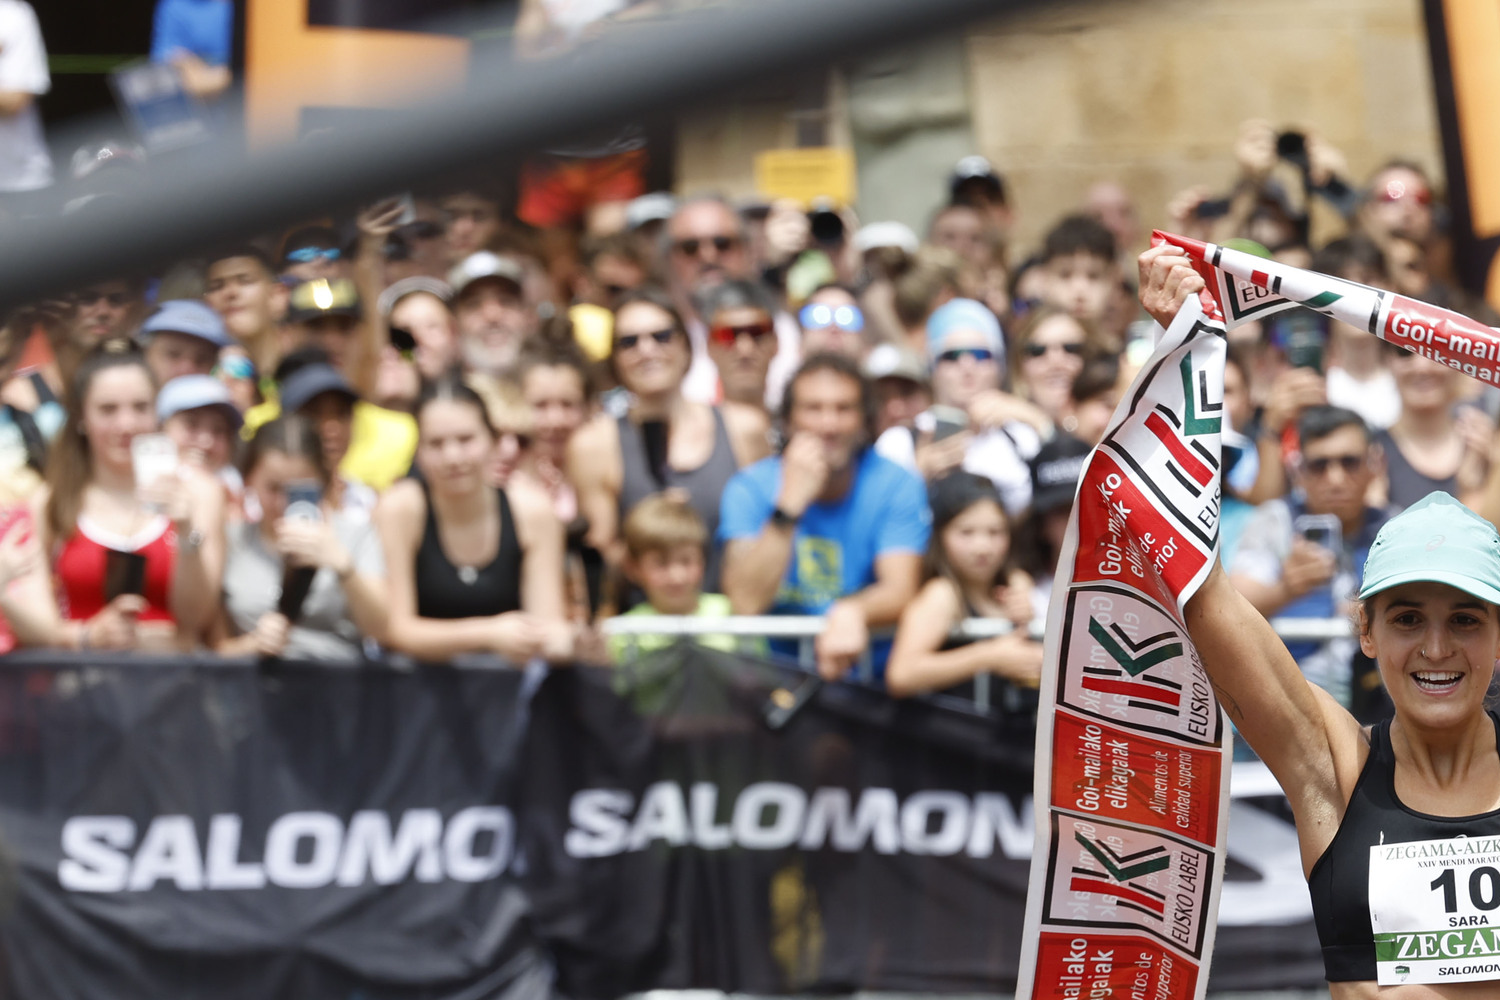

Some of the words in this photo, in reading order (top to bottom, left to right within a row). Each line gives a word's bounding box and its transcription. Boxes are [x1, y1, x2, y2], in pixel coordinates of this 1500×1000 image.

[1153, 537, 1178, 575] erior
[1188, 683, 1209, 736] EUSKO
[1077, 724, 1102, 811] Goi-mailako
[1105, 739, 1135, 810] elikagaiak
[1156, 751, 1168, 763] de
[1175, 750, 1193, 788] superior
[1150, 763, 1168, 815] Alimentos
[1171, 788, 1192, 828] calidad
[563, 780, 1035, 859] SALOMON
[58, 804, 516, 893] SALOMO
[1418, 860, 1437, 868] XXIV
[1439, 858, 1466, 867] MENDI
[1179, 852, 1199, 894] LABEL
[1172, 893, 1194, 944] EUSKO
[1449, 915, 1489, 927] SARA
[1138, 952, 1153, 969] de
